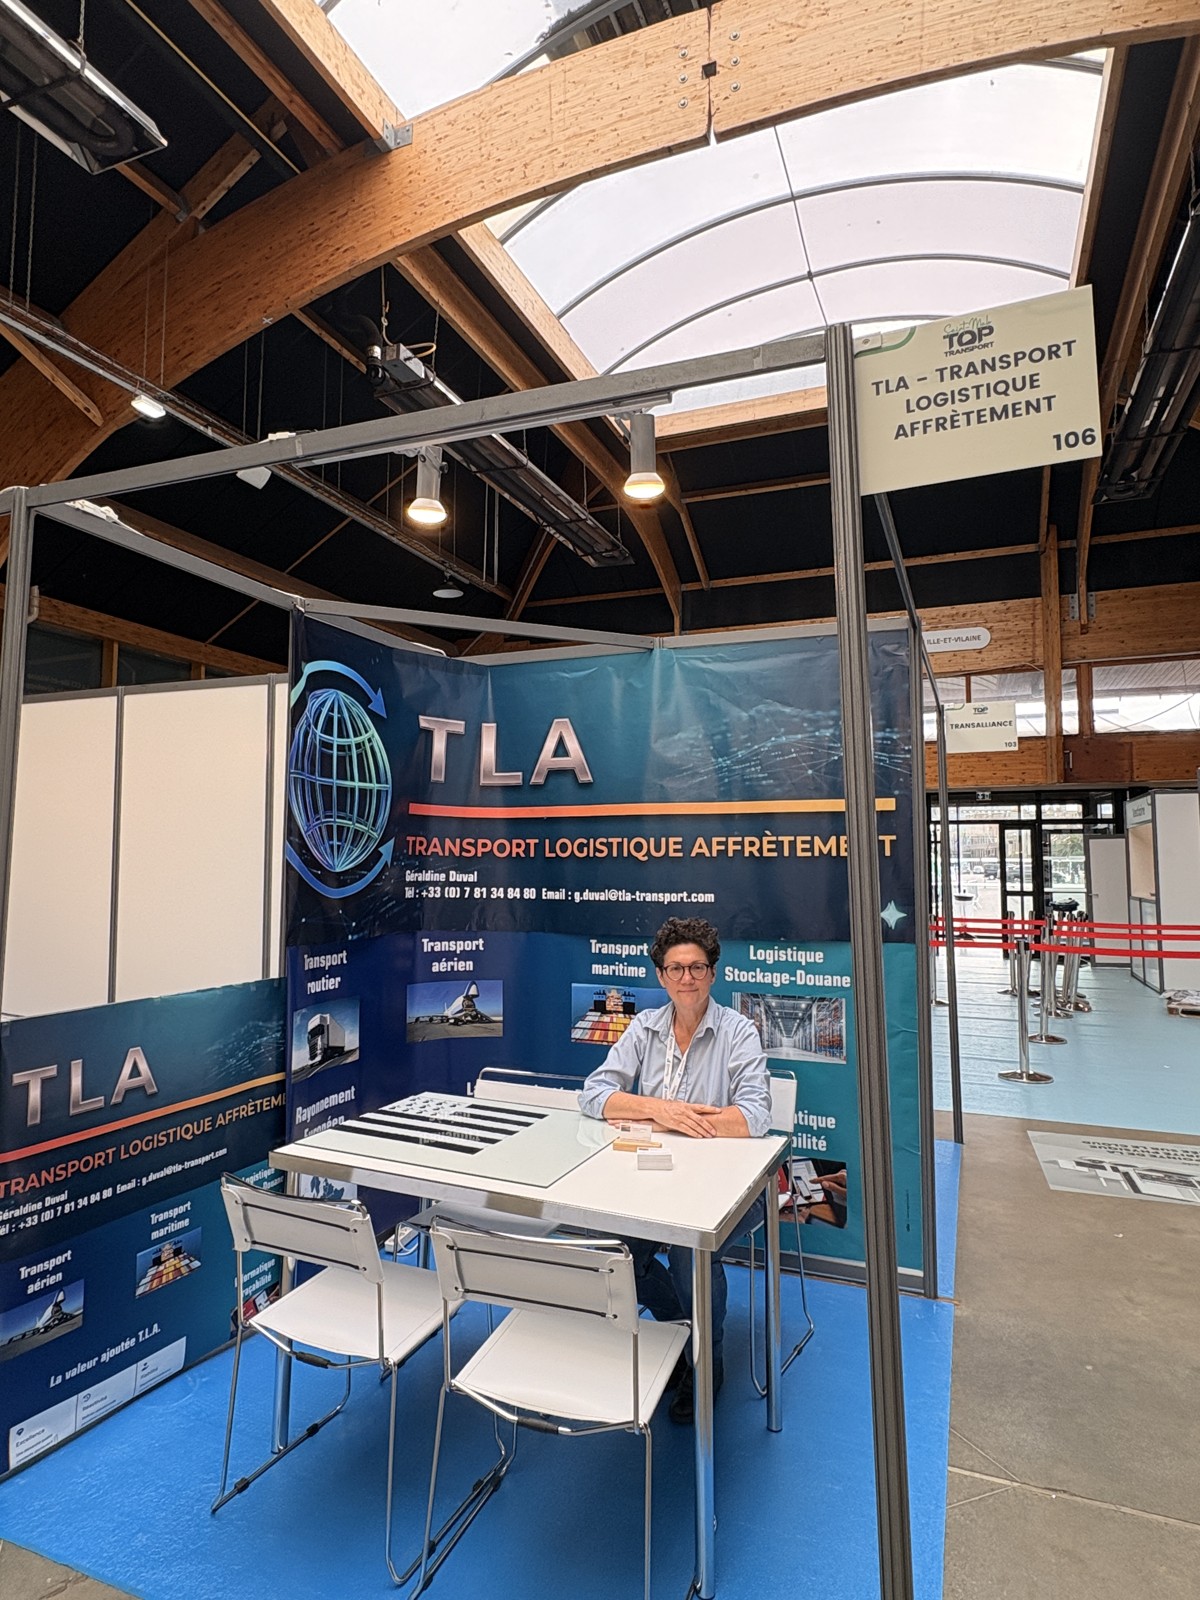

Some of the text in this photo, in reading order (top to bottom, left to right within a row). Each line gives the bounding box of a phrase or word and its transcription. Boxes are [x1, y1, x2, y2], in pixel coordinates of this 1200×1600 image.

[943, 325, 994, 350] TOP
[944, 341, 994, 357] TRANSPORT
[871, 375, 910, 396] TLA
[935, 340, 1077, 383] TRANSPORT
[905, 372, 1041, 414] LOGISTIQUE
[894, 395, 1057, 440] AFFRÈTEMENT
[1053, 428, 1097, 450] 106
[926, 634, 982, 645] ILLE-ET-VILAINE
[950, 720, 1013, 730] TRANSALLIANCE
[418, 714, 594, 786] TLA
[406, 830, 897, 862] TRANSPORT LOGISTIQUE AFFRÈTEMET
[405, 869, 478, 882] Géraldine Duval
[405, 886, 414, 899] Tél
[421, 886, 441, 898] +33
[445, 886, 460, 898] (0)
[464, 887, 470, 899] 7
[473, 887, 487, 899] 81
[490, 887, 504, 899] 34
[507, 887, 520, 899] 84
[523, 887, 536, 899] 80
[542, 887, 565, 900] Email
[574, 889, 715, 904] g.duval@tla-transport.com
[422, 937, 484, 954] Transport
[590, 939, 649, 958] Transport
[749, 944, 824, 966] Logistique
[304, 950, 348, 971] Transport
[431, 958, 474, 973] aérien
[591, 962, 646, 978] maritime
[307, 974, 341, 994] routier
[724, 966, 851, 988] Stockage-Douane
[11, 1046, 159, 1127] TLA
[295, 1085, 356, 1125] Rayonnement
[0, 1147, 117, 1199] TRANSPORT
[120, 1116, 213, 1159] LOGISTIQUE
[0, 1223, 10, 1236] él
[18, 1214, 38, 1230] +33
[41, 1209, 54, 1223] (0)
[56, 1205, 62, 1217] 7
[64, 1201, 75, 1213] 81
[77, 1195, 88, 1209] 34
[90, 1191, 101, 1204] 84
[102, 1187, 113, 1199] 80
[116, 1178, 136, 1194] Email
[44, 1189, 68, 1207] Duval
[150, 1201, 192, 1225] Transport
[150, 1217, 190, 1241] maritime
[19, 1250, 72, 1280] Transport
[27, 1271, 63, 1295] aérien
[49, 1322, 161, 1389] La valeur ajoutée T.L.A.
